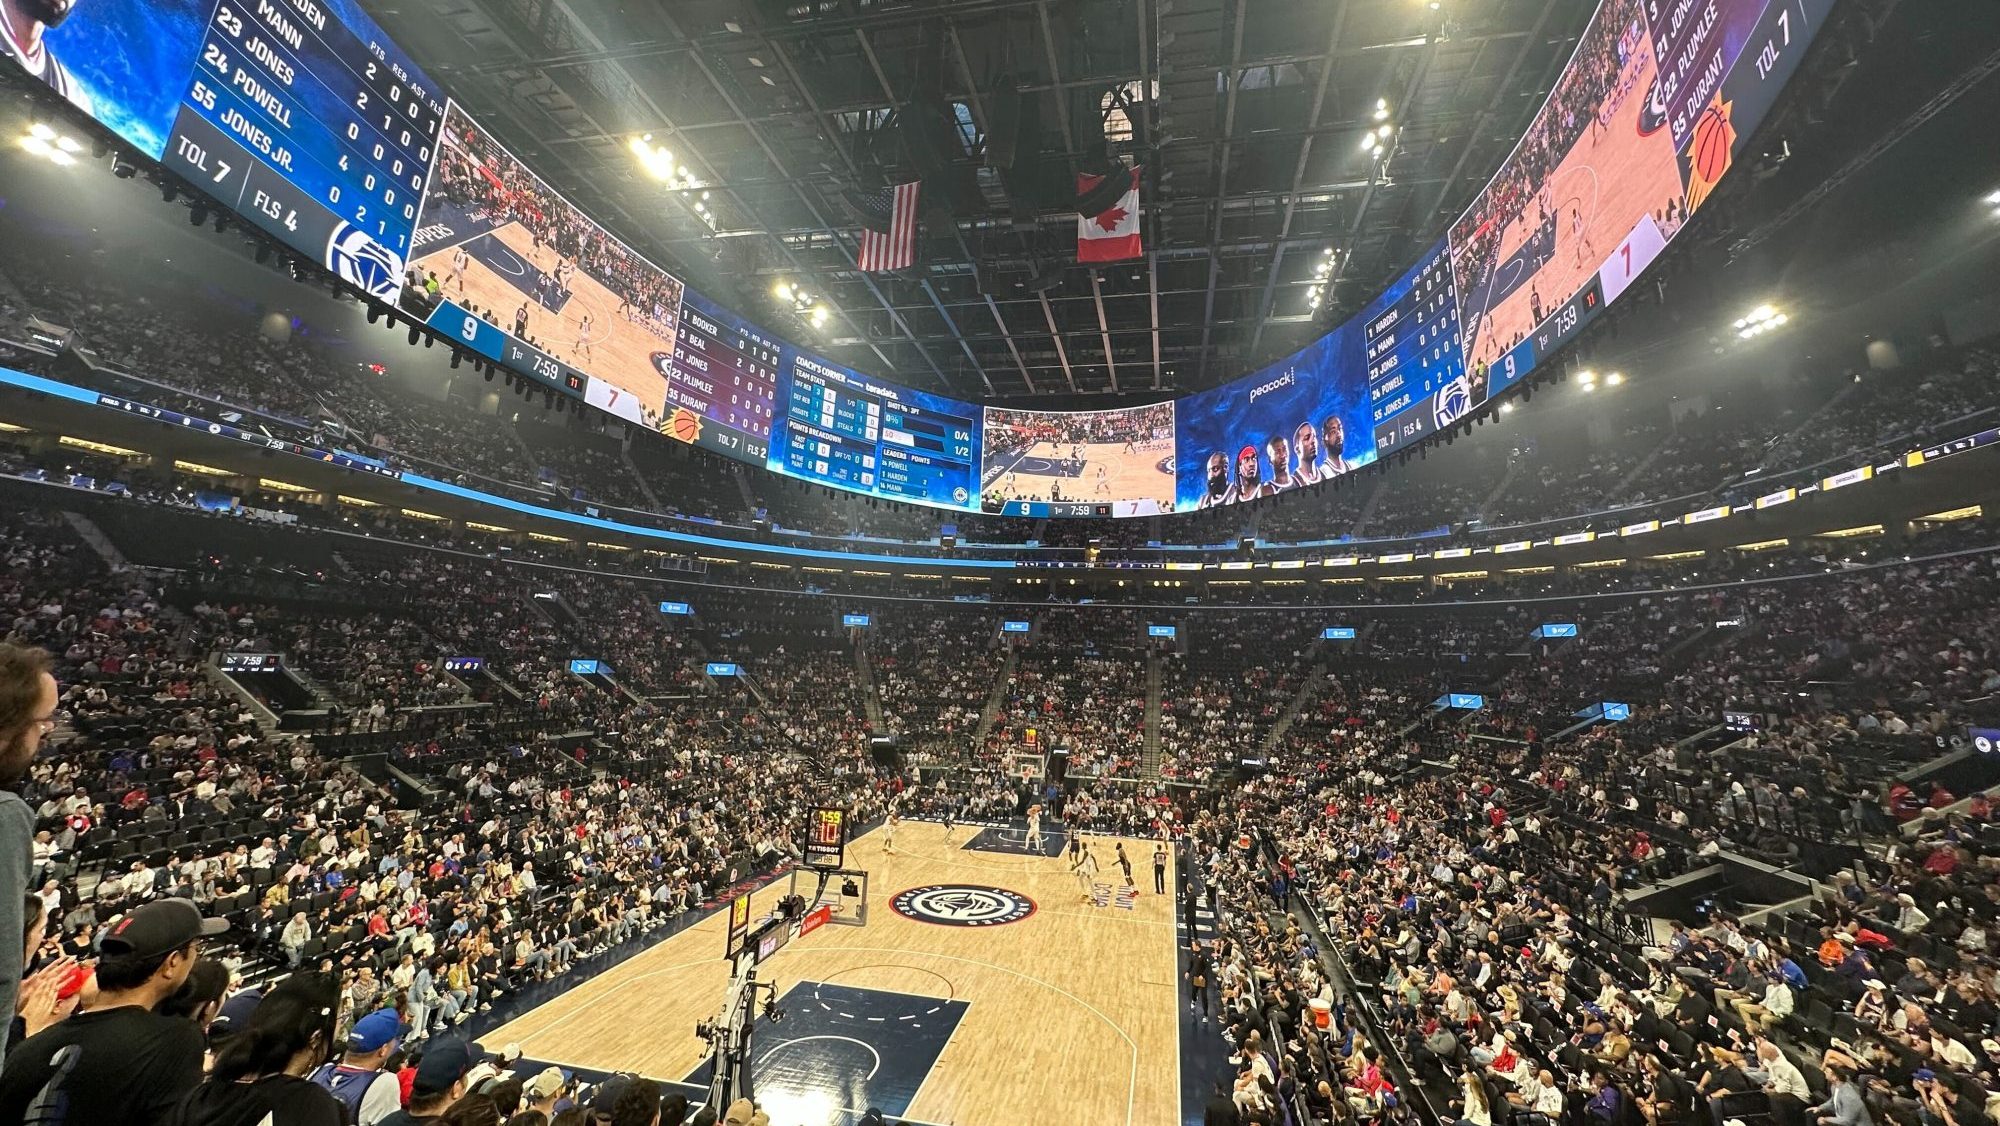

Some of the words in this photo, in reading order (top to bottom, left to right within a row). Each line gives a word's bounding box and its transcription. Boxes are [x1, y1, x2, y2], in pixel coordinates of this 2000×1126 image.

[1650, 4, 1658, 22] 3
[1656, 38, 1668, 63] 21
[1664, 73, 1678, 102] 22
[1678, 2, 1718, 79] PLUMLEE
[1755, 39, 1780, 80] TOL
[1777, 8, 1789, 47] 7
[258, 1, 303, 50] MANN
[357, 92, 368, 110] 2
[383, 115, 391, 130] 1
[401, 130, 411, 147] 0
[419, 146, 429, 162] 0
[370, 41, 385, 61] PTS
[391, 63, 407, 82] REB
[411, 82, 426, 100] AST
[430, 99, 443, 116] FLS
[217, 7, 242, 38] 23
[246, 37, 295, 86] JONES
[348, 122, 359, 140] 0
[373, 144, 384, 161] 0
[393, 160, 403, 176] 0
[412, 174, 421, 190] 0
[366, 62, 377, 80] 2
[390, 85, 400, 102] 0
[409, 102, 419, 119] 0
[428, 120, 436, 135] 1
[1672, 111, 1687, 141] 35
[1687, 47, 1724, 120] DURANT
[204, 43, 228, 74] 24
[233, 68, 291, 129] POWELL
[339, 155, 349, 171] 4
[365, 174, 375, 191] 0
[385, 189, 394, 205] 0
[404, 204, 414, 220] 0
[178, 135, 207, 172] TOL
[213, 160, 231, 183] 7
[191, 80, 217, 111] 55
[220, 108, 272, 155] JONES
[271, 147, 293, 172] JR.
[329, 186, 340, 203] 0
[356, 205, 367, 222] 2
[378, 220, 386, 235] 1
[398, 234, 405, 248] 1
[253, 190, 281, 219] FLS
[284, 210, 297, 231] 4
[1432, 256, 1440, 269] AST
[1368, 328, 1373, 338] 1
[1375, 309, 1398, 334] HARDEN
[1414, 290, 1420, 302] 2
[1426, 279, 1432, 292] 0
[1436, 270, 1441, 282] 0
[1445, 262, 1450, 273] 1
[1504, 354, 1516, 379] 9
[1538, 334, 1549, 350] 1ST
[1554, 304, 1577, 338] 7:59
[1586, 292, 1595, 307] 11
[1620, 242, 1631, 277] 7
[683, 309, 688, 319] 1
[692, 314, 718, 336] BOOKER
[753, 347, 757, 356] 1
[1369, 348, 1376, 359] 14
[1377, 334, 1395, 354] MANN
[1417, 311, 1423, 324] 2
[1429, 302, 1434, 313] 1
[1438, 294, 1444, 306] 0
[1448, 284, 1453, 296] 0
[679, 328, 685, 339] 3
[689, 334, 706, 350] BEAL
[737, 358, 743, 367] 2
[1370, 367, 1379, 380] 23
[1380, 355, 1398, 375] JONES
[1420, 334, 1425, 346] 0
[1431, 325, 1437, 337] 0
[1441, 317, 1446, 329] 0
[1451, 308, 1456, 320] 0
[462, 316, 478, 341] 9
[512, 346, 523, 360] 1ST
[532, 355, 559, 380] 7:59
[570, 377, 578, 389] 11
[608, 389, 619, 408] 7
[674, 348, 684, 360] 21
[686, 354, 708, 372] JONES
[758, 386, 763, 396] 1
[796, 356, 821, 372] COACH'S
[821, 367, 846, 383] CORNER
[1372, 387, 1381, 400] 24
[1382, 374, 1404, 394] POWELL
[1422, 357, 1427, 368] 4
[1434, 348, 1440, 360] 0
[1444, 340, 1449, 353] 0
[1454, 332, 1459, 345] 0
[671, 367, 682, 380] 22
[683, 373, 714, 395] PLUMLEE
[796, 368, 810, 381] TEAM
[810, 374, 826, 387] STATS
[1250, 372, 1291, 403] peacock
[1374, 409, 1383, 421] 55
[1384, 399, 1402, 419] JONES
[1425, 380, 1430, 391] 0
[1436, 372, 1442, 384] 2
[1447, 365, 1452, 376] 1
[1457, 357, 1462, 369] 1
[668, 388, 678, 400] 35
[680, 393, 708, 413] DURANT
[729, 413, 735, 423] 3
[885, 414, 899, 424] 0%
[124, 402, 131, 411] 4
[153, 409, 161, 418] 7
[241, 431, 252, 441] 1ST
[265, 437, 285, 450] 7:59
[346, 459, 352, 467] 7
[718, 433, 730, 446] TOL
[731, 437, 738, 449] 7
[789, 420, 808, 433] POINTS
[809, 426, 842, 443] BREAKDOWN
[837, 421, 854, 432] STEALS
[954, 431, 969, 441] 0/4
[1378, 434, 1388, 450] TOL
[1389, 431, 1395, 445] 7
[1403, 423, 1415, 437] FLS
[1416, 418, 1422, 431] 4
[748, 444, 759, 456] FLS
[760, 447, 767, 458] 2
[883, 448, 907, 460] LEADERS
[911, 455, 931, 464] POINTS
[954, 446, 969, 457] 1/2
[1968, 438, 1975, 447] 7
[887, 471, 908, 482] HARDEN
[888, 460, 908, 471] POWELL
[886, 483, 903, 492] MANN
[1021, 503, 1031, 515] 9
[1070, 505, 1090, 515] 7:59
[1130, 503, 1138, 514] 7
[243, 655, 262, 665] 7:59
[819, 811, 841, 824] 7:59
[896, 885, 944, 916] CLIPPERS
[993, 888, 1022, 900] LOS
[967, 902, 1030, 926] ANGELES
